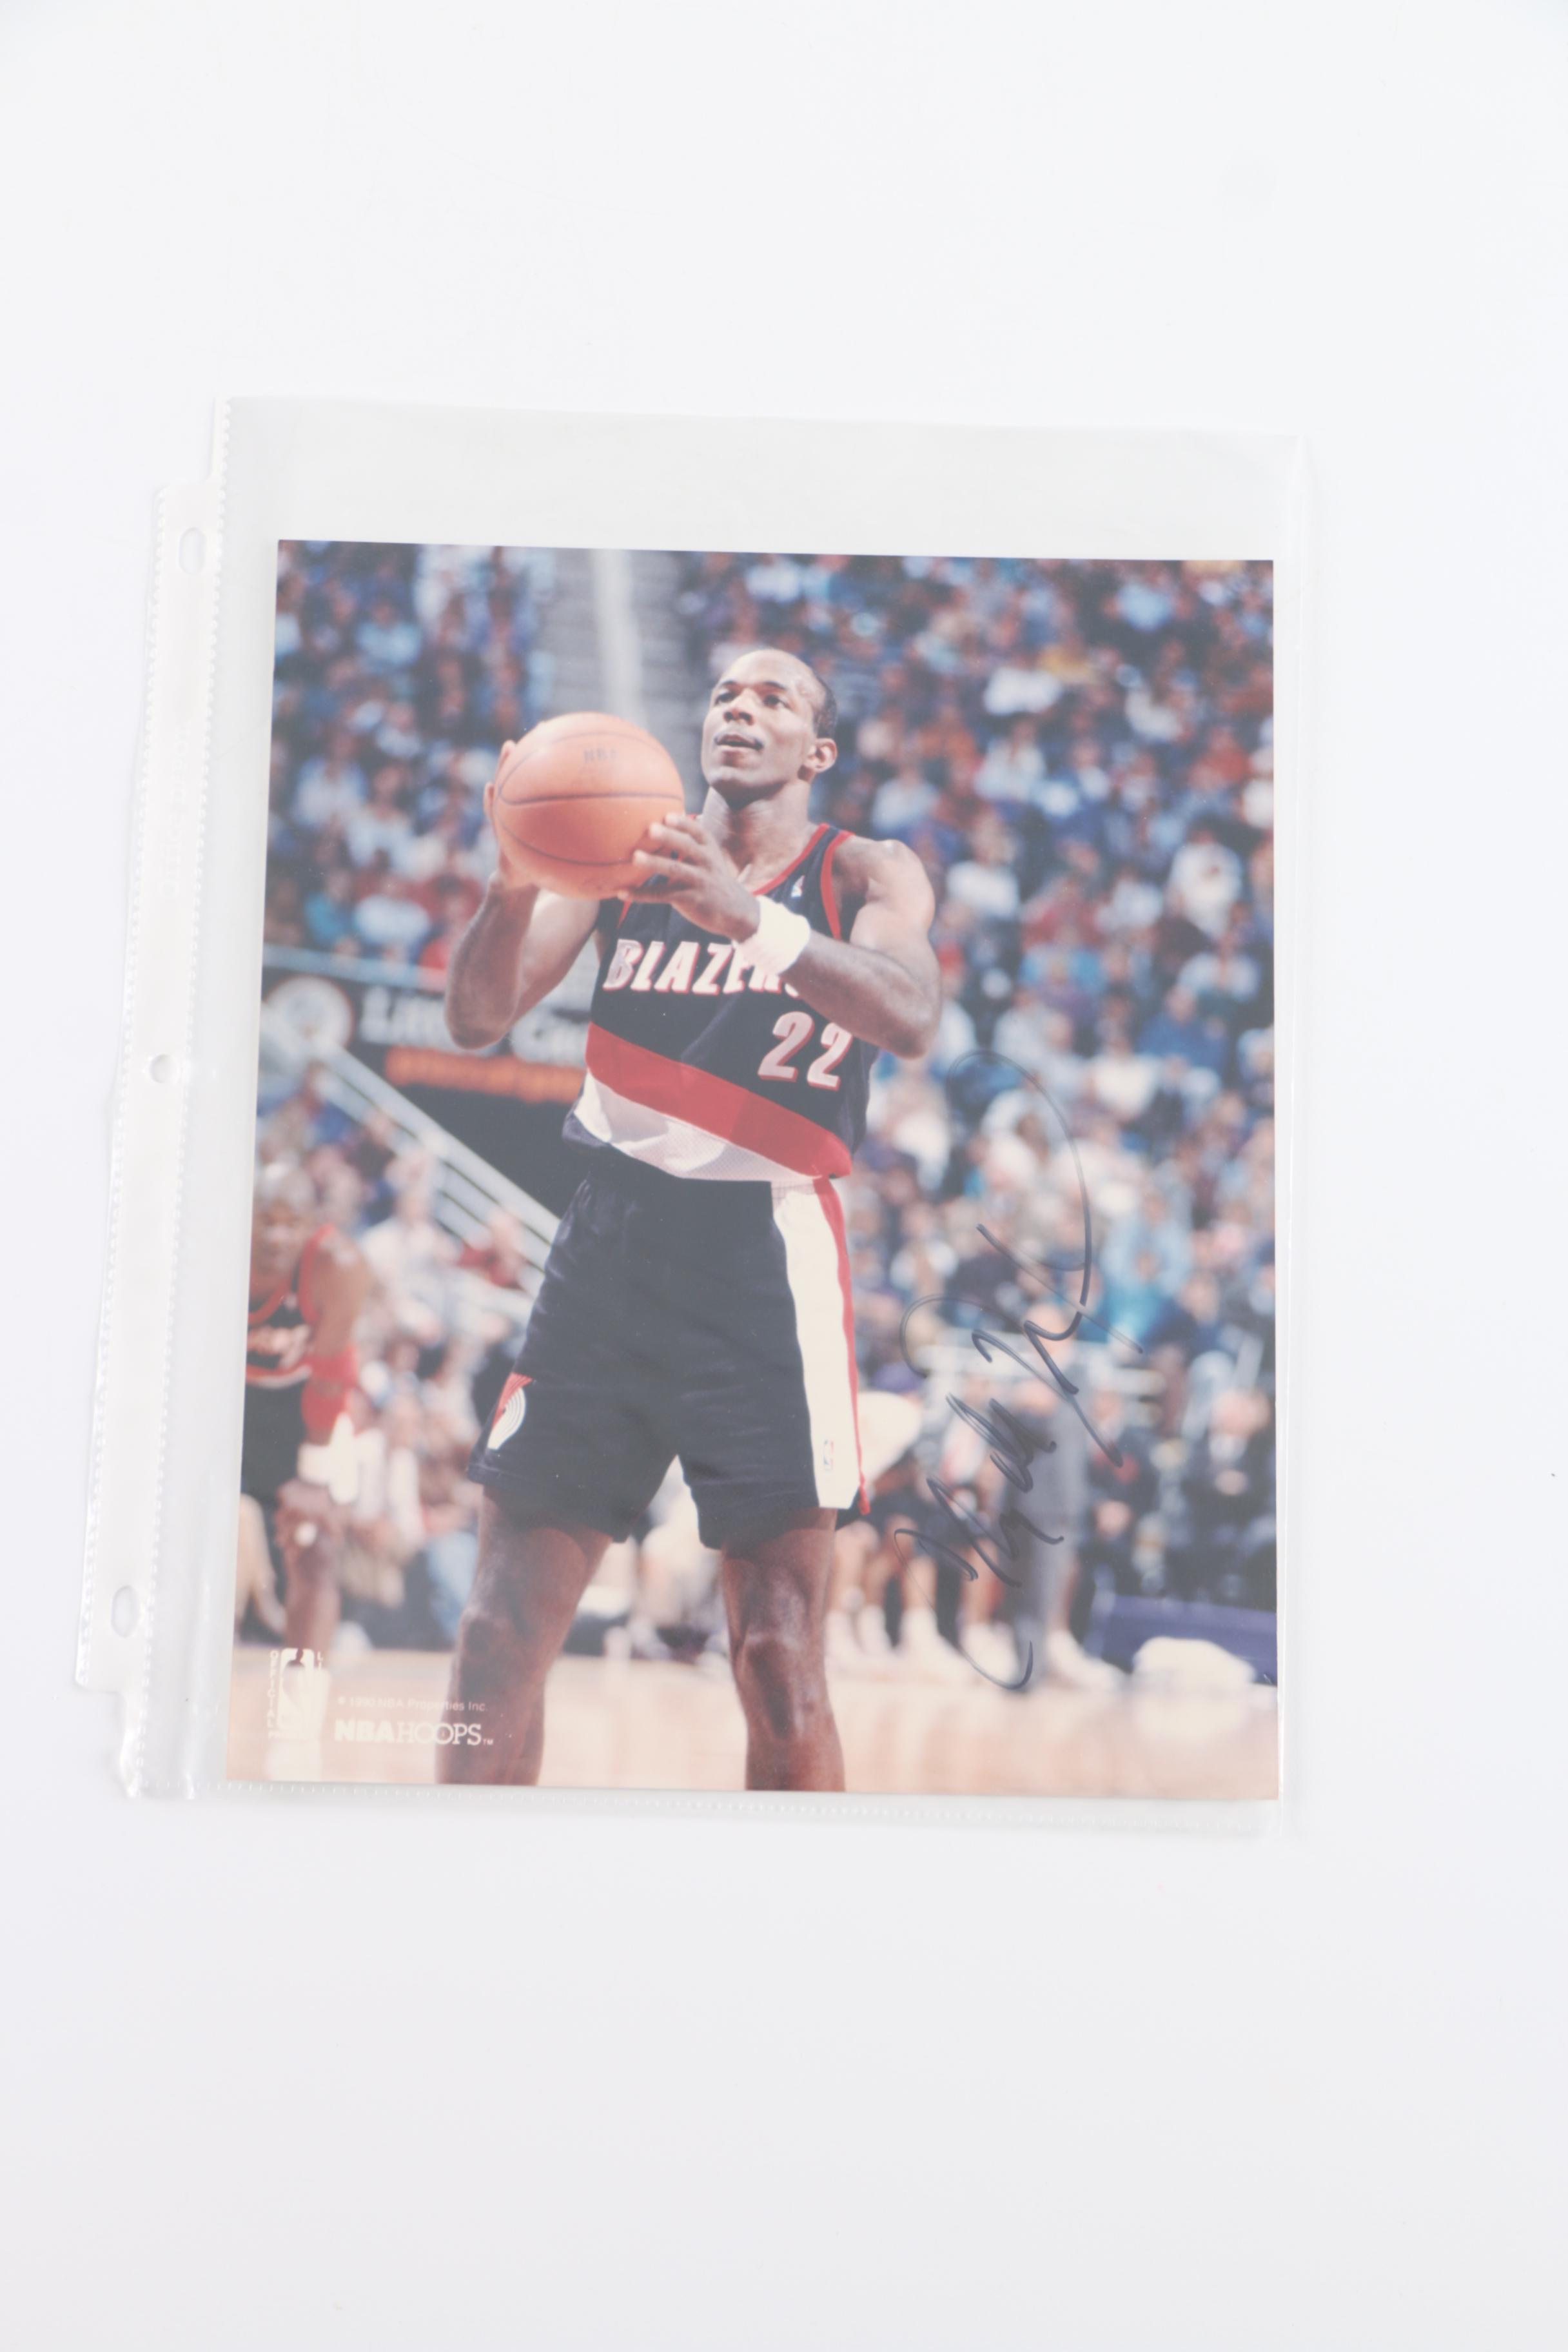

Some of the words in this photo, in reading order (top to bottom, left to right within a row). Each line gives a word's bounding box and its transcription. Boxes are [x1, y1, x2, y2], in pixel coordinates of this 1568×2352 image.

[602, 937, 800, 998] BLAZE
[757, 1010, 854, 1092] 22
[407, 1698, 465, 1712] Properties
